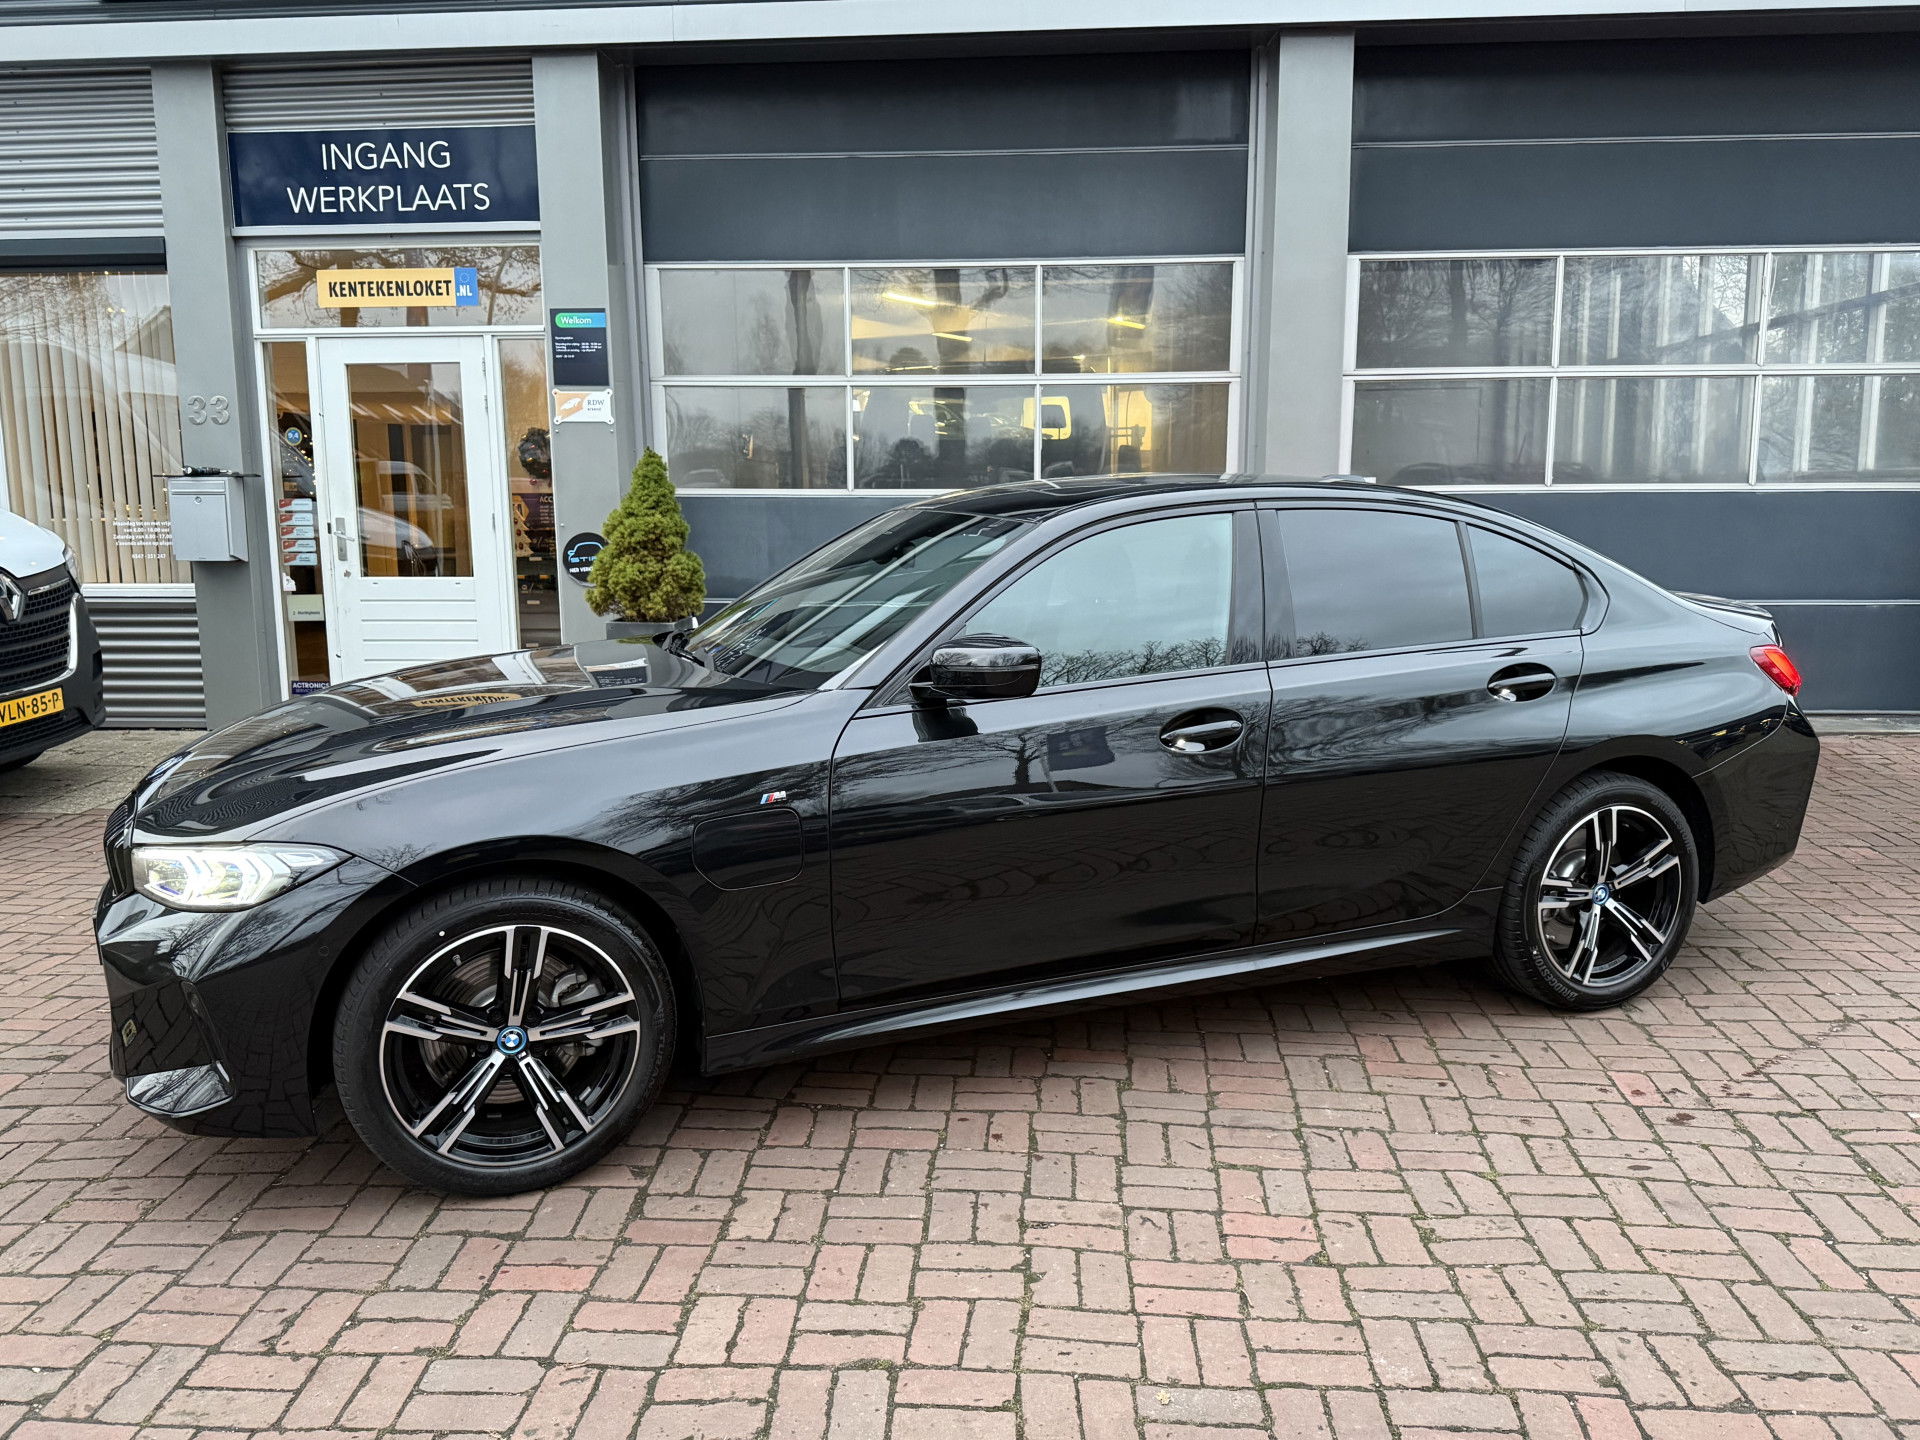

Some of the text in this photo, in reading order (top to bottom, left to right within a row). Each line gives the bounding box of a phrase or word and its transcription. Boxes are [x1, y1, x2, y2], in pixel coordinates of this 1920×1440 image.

[321, 140, 451, 170] INGANG
[286, 182, 491, 213] WERKPLAATS
[328, 279, 472, 298] KENTEKENLOKET .NL
[560, 316, 592, 325] Welkom
[187, 395, 231, 426] 33
[0, 691, 60, 723] VLN-85-P
[1530, 945, 1578, 1001] BRIDGESTONE
